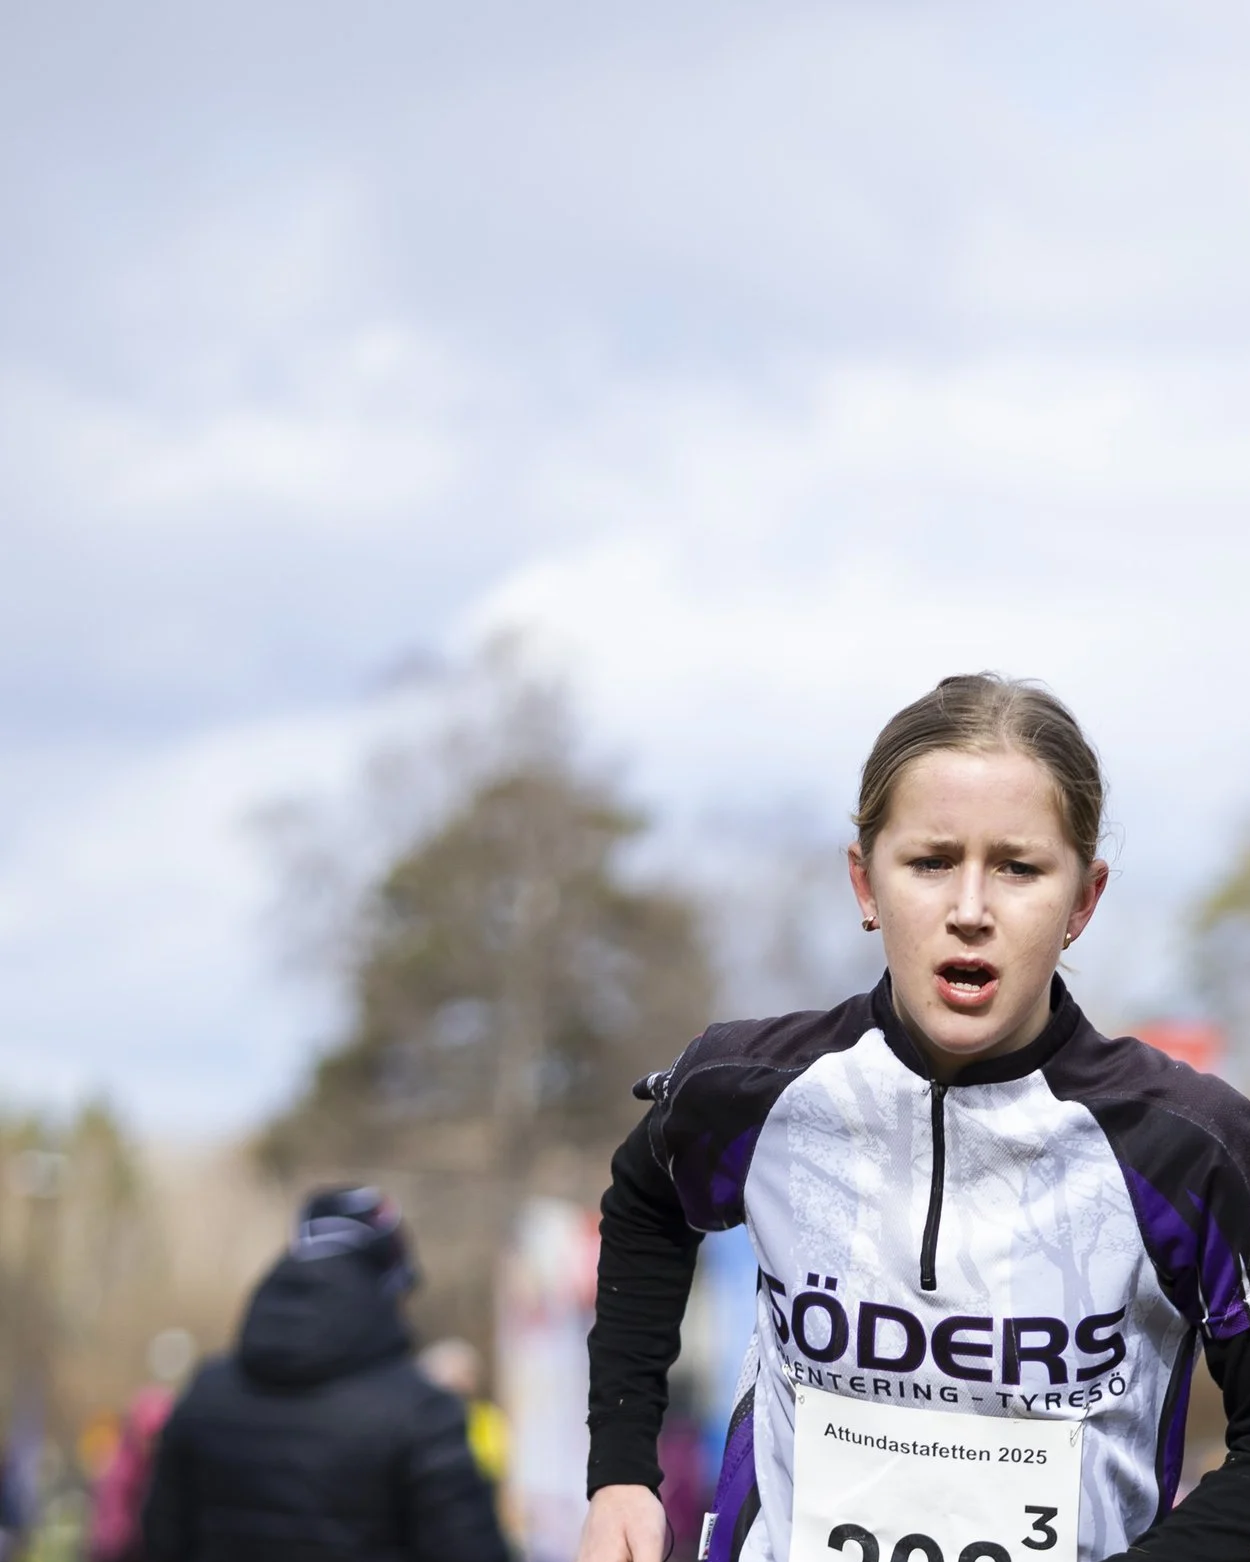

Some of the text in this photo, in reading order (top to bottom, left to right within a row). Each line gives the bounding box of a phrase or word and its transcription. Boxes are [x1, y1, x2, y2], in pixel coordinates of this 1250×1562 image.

[763, 1272, 1127, 1386] SÖDERS
[995, 1371, 1126, 1412] TYRESÖ
[824, 1422, 1048, 1465] Attundastafetten 2025
[1021, 1504, 1059, 1551] 3
